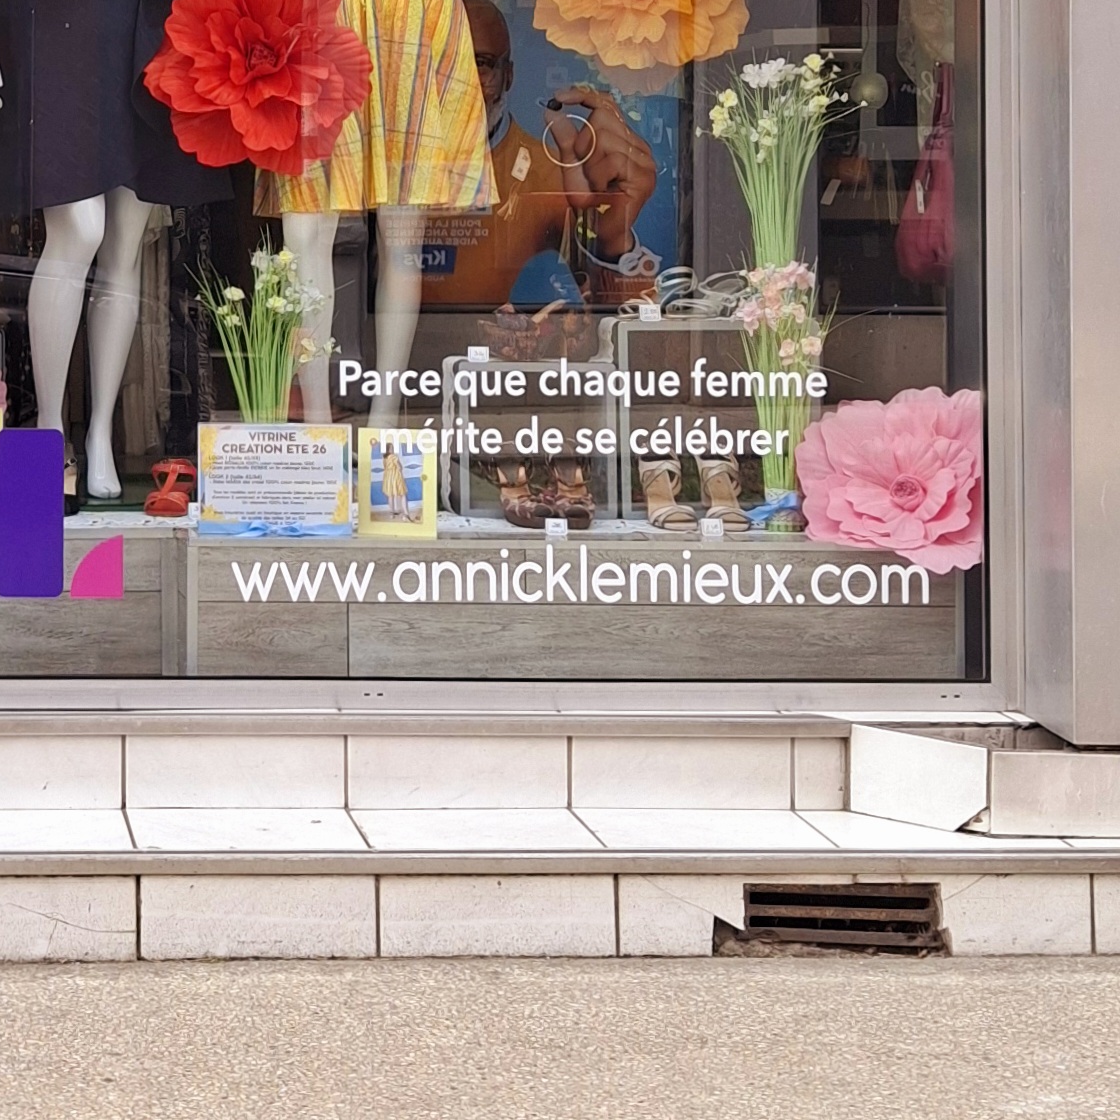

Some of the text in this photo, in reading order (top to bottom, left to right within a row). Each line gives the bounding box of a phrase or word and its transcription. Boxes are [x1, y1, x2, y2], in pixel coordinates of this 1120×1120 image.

[339, 358, 828, 408] Parce que chaque femme
[222, 443, 326, 454] CREATION ETE 26
[248, 432, 296, 442] VITRINE
[380, 416, 790, 456] mérite de se célébrer
[231, 544, 932, 605] www.annicklemieux.com
